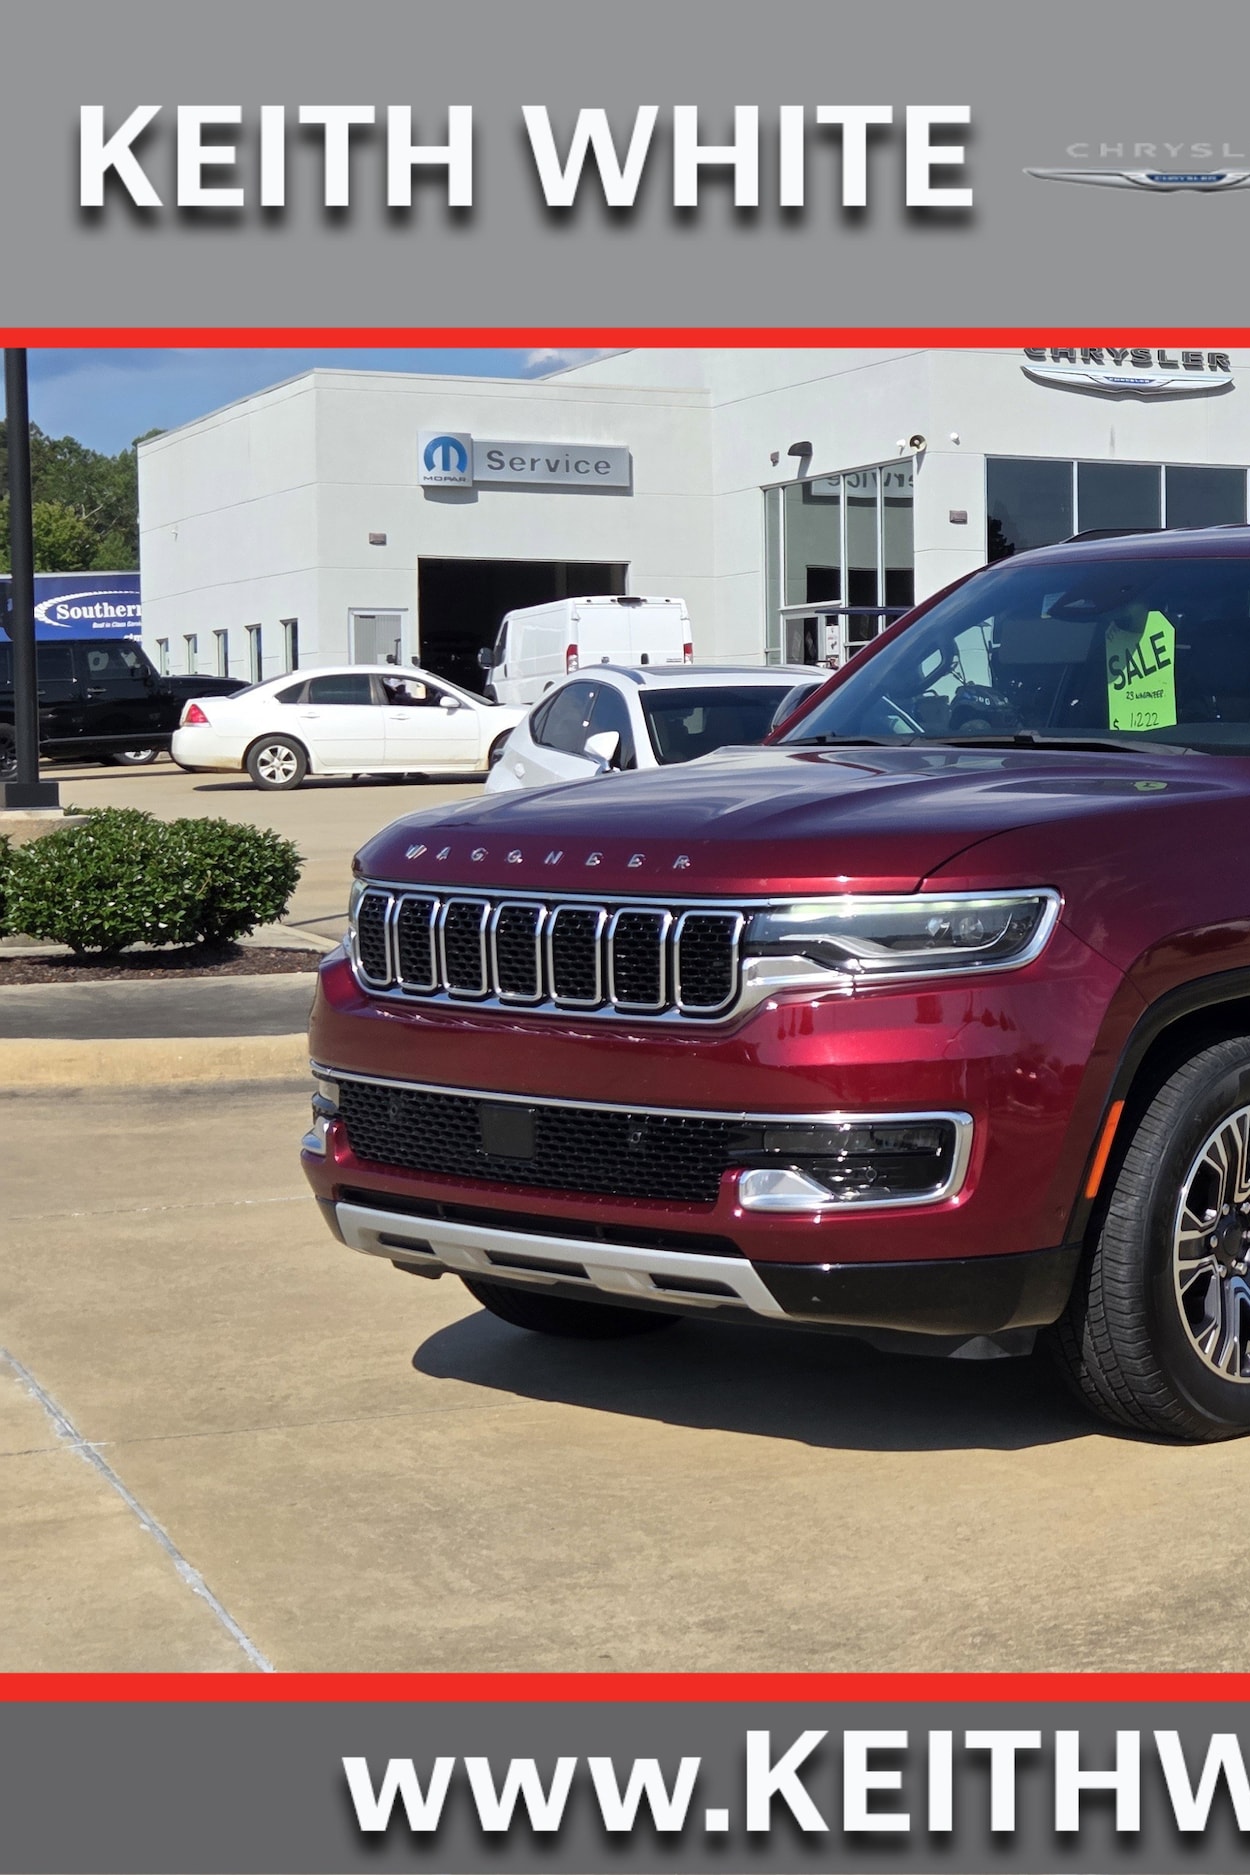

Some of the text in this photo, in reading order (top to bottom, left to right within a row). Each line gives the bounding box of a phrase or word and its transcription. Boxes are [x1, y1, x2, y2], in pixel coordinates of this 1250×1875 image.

[486, 449, 612, 475] Service
[1108, 631, 1172, 691] SALE
[405, 844, 691, 870] WAGONEER
